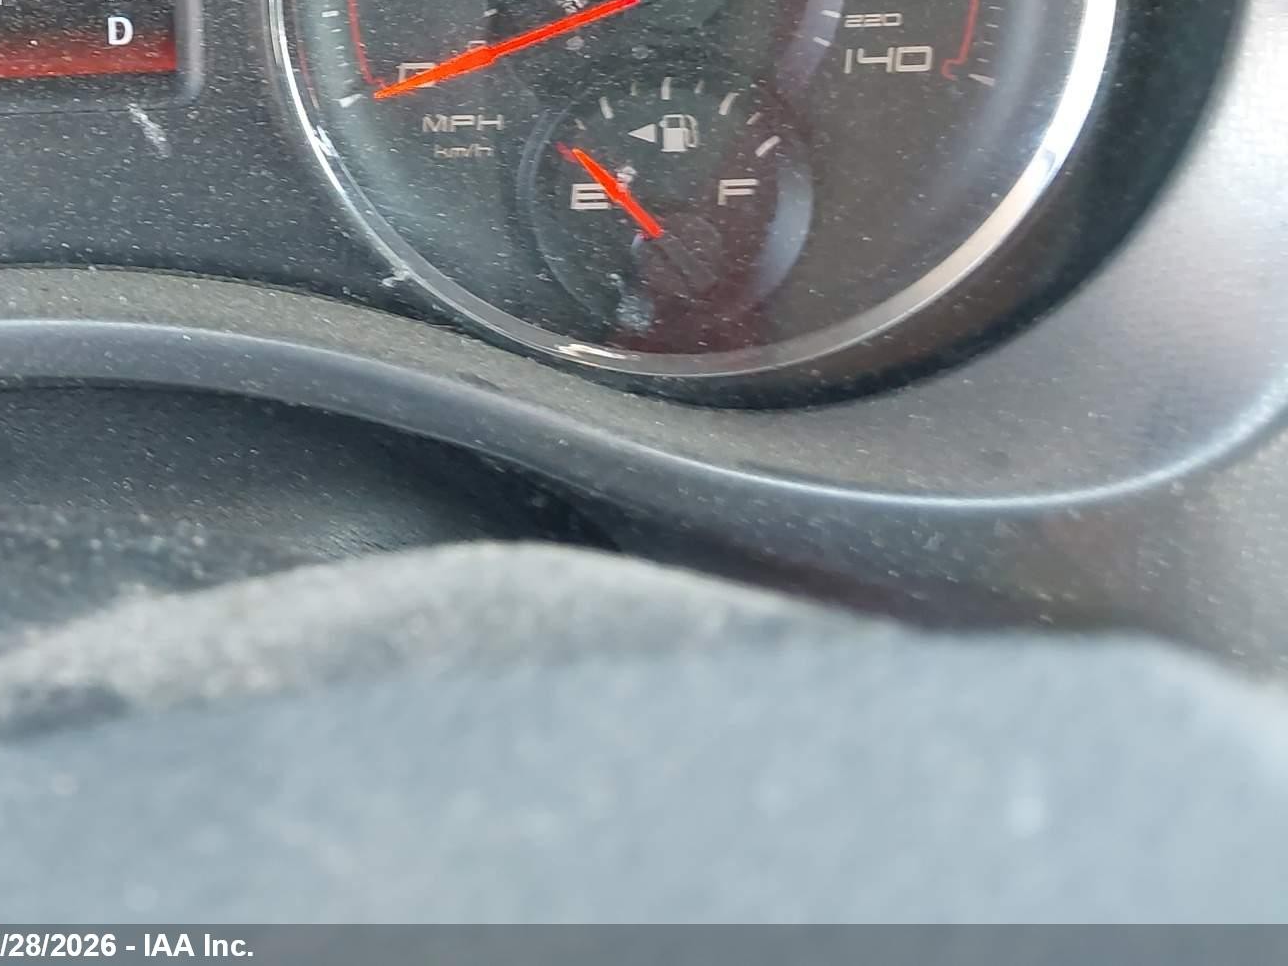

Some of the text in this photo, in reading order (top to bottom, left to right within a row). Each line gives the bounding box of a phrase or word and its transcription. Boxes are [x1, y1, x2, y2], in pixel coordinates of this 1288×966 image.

[107, 17, 133, 45] D
[843, 13, 901, 28] 220
[843, 46, 933, 75] 140
[422, 114, 504, 133] MPH
[570, 183, 624, 210] E
[718, 179, 761, 205] F
